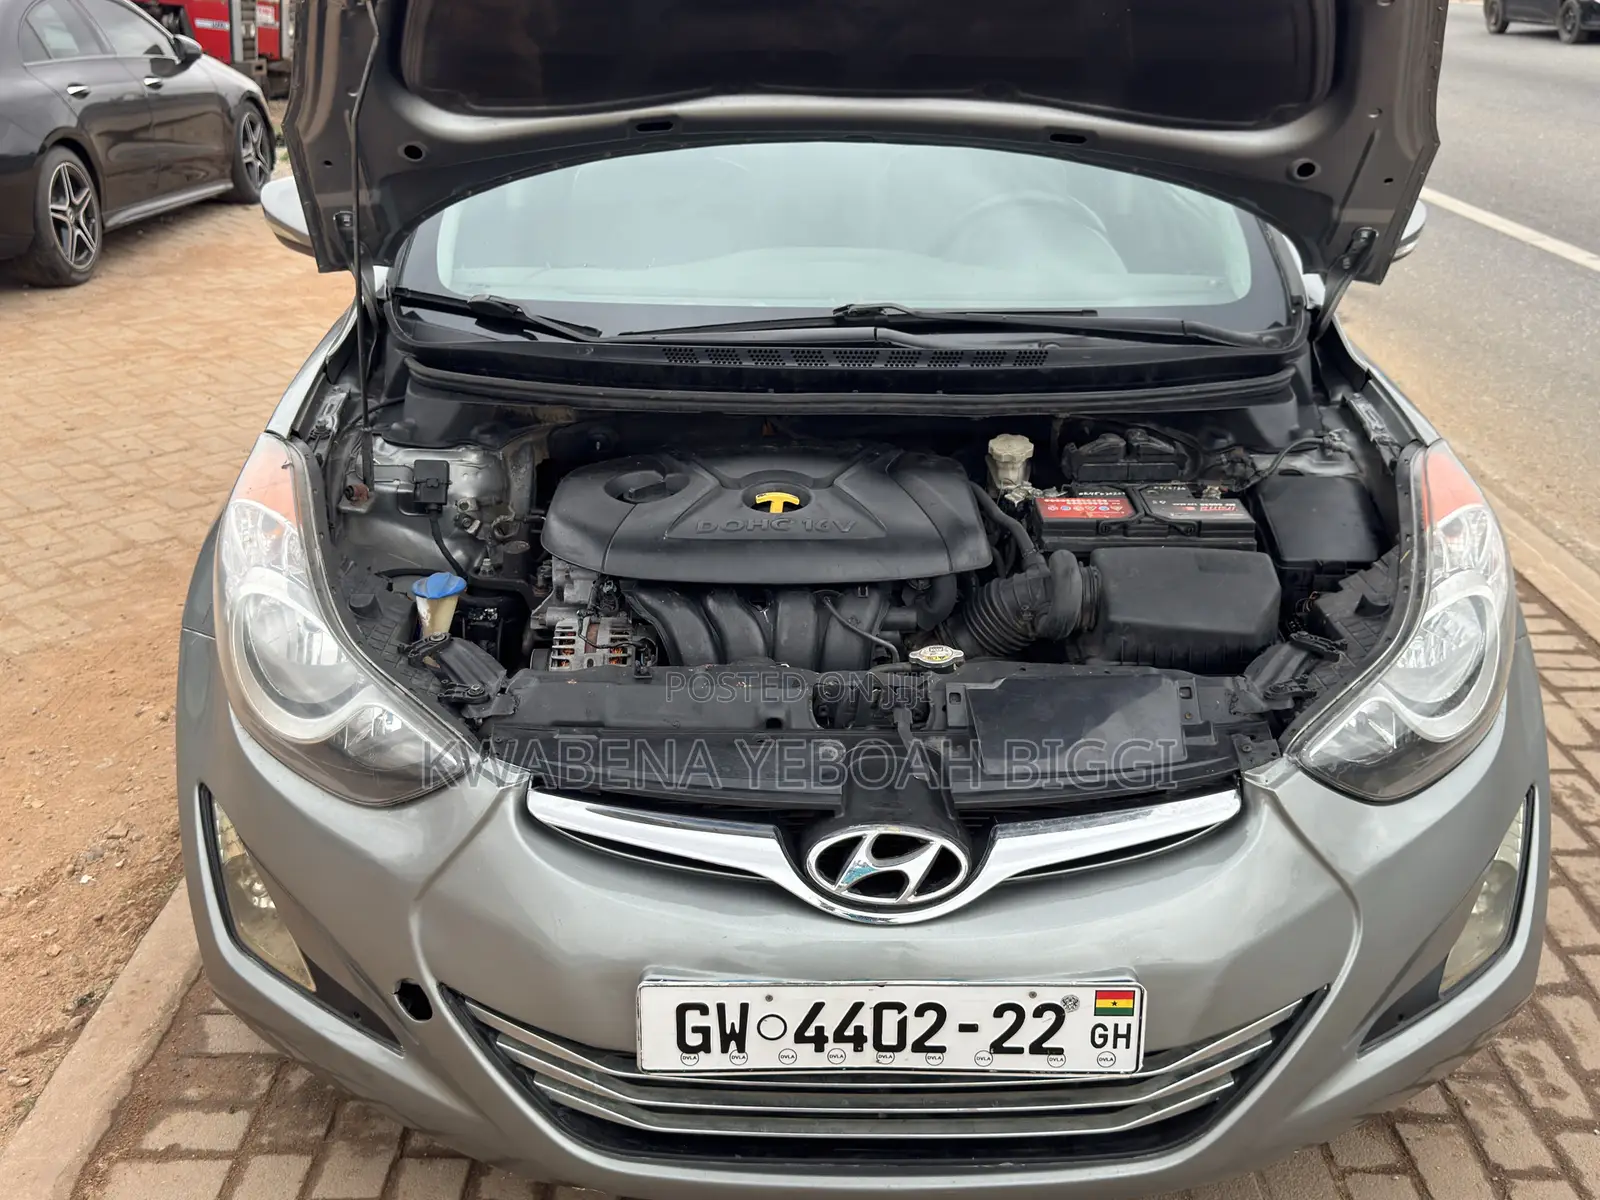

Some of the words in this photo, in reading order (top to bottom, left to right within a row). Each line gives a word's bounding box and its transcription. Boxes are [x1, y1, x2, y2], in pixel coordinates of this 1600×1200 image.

[696, 518, 793, 534] DOHC
[801, 517, 856, 534] 16V
[675, 1001, 750, 1054] GW
[1090, 1022, 1132, 1049] GH
